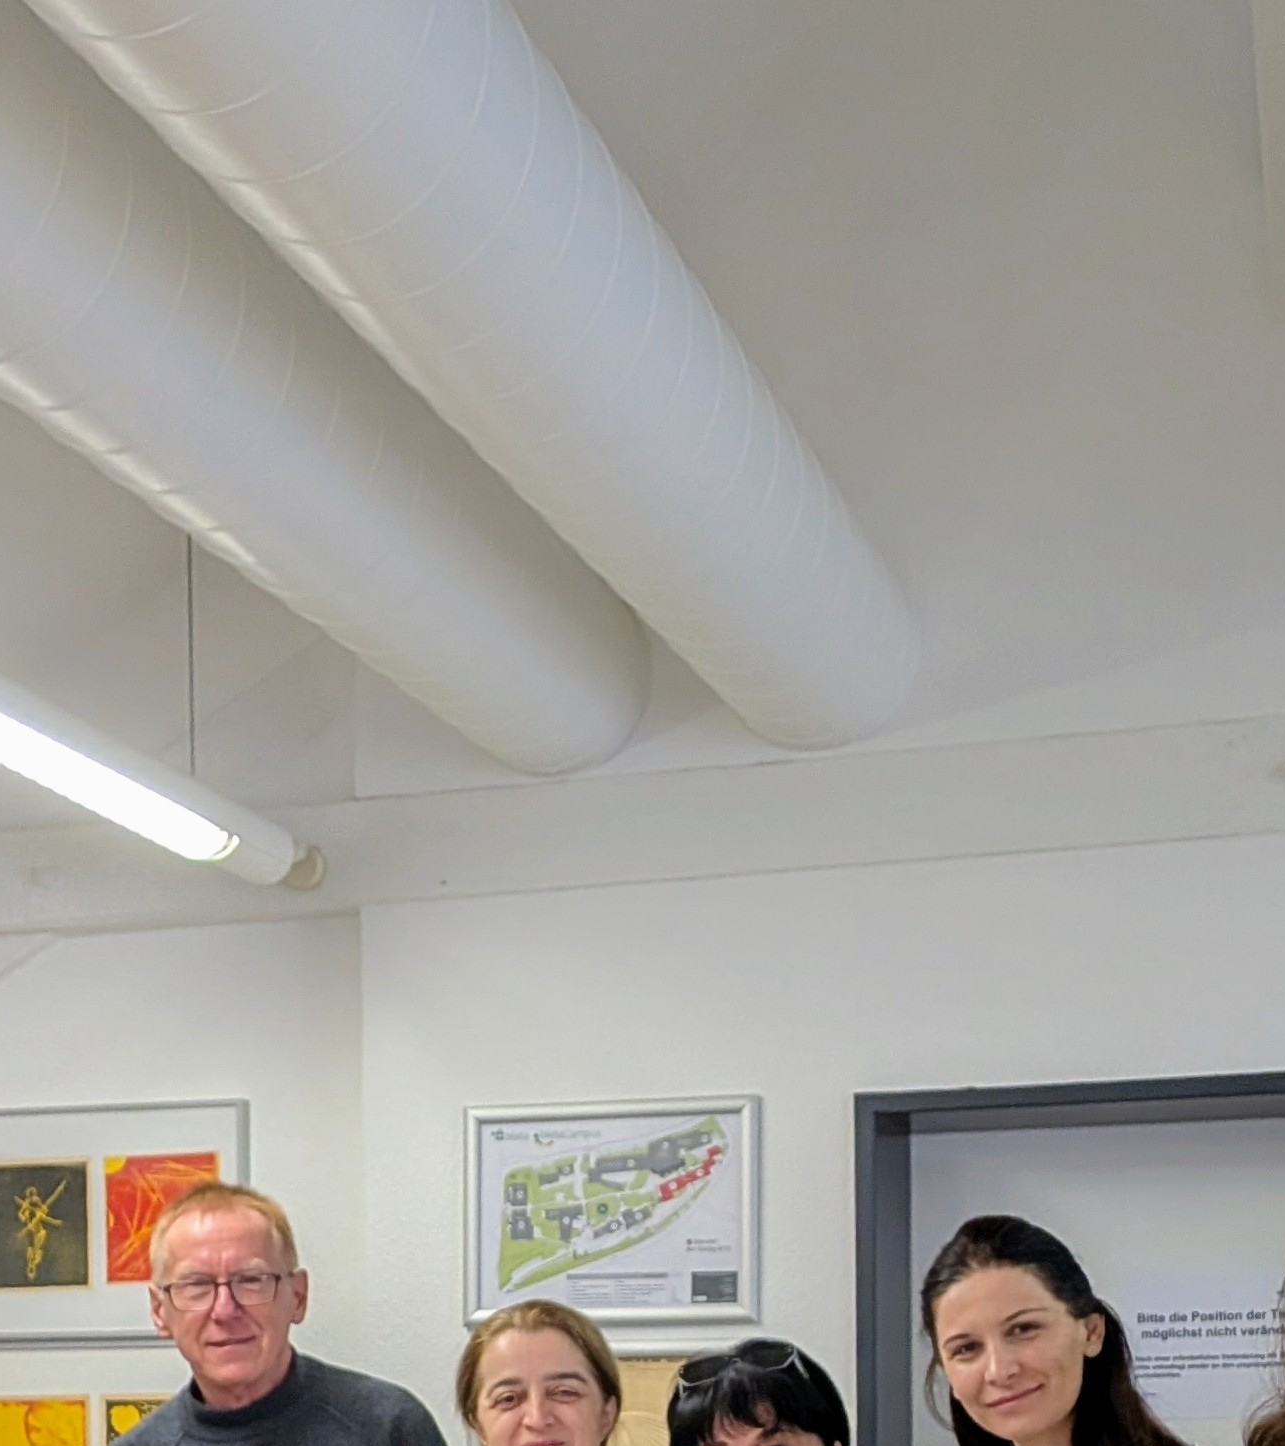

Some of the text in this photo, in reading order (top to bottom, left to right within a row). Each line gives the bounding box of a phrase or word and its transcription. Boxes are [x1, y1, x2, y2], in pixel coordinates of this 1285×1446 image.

[1137, 1312, 1165, 1323] Bitte
[1169, 1311, 1188, 1322] die
[1191, 1310, 1243, 1323] Position
[1246, 1309, 1266, 1320] der
[1141, 1327, 1202, 1341] möglichst
[1206, 1326, 1237, 1338] nicht
